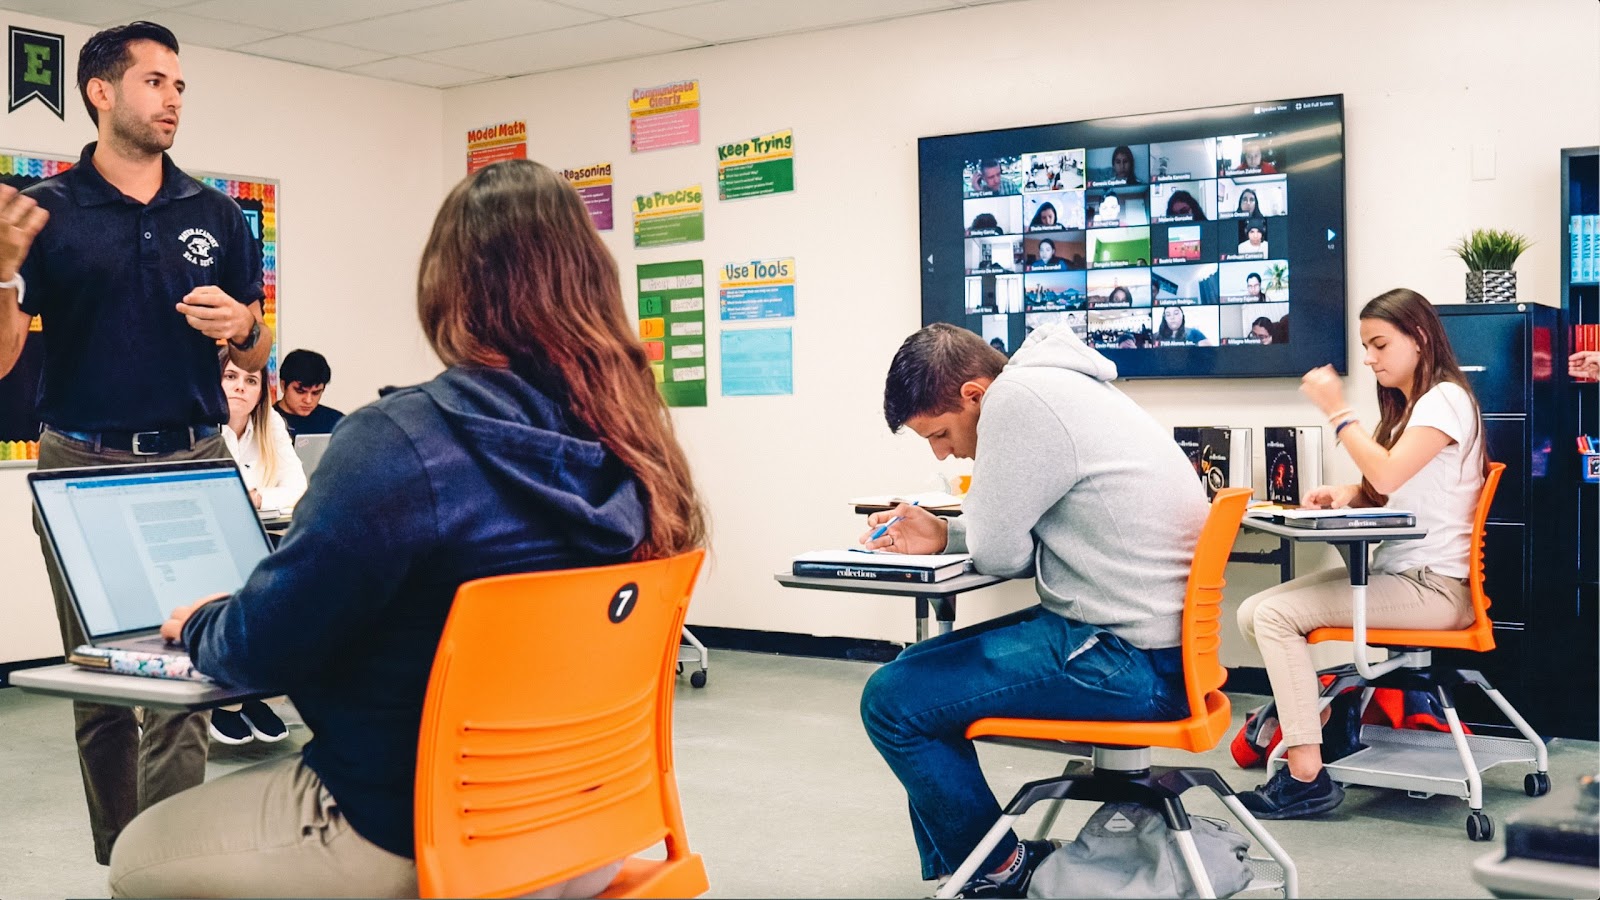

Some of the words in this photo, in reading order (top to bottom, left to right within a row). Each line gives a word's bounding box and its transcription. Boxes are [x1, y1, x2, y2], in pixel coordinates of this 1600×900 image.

[23, 43, 52, 86] E
[633, 82, 694, 103] Communicate
[649, 95, 681, 108] Clearly
[467, 126, 497, 143] Model
[499, 121, 526, 137] Math
[718, 144, 750, 161] Keep
[751, 135, 792, 154] Trying
[564, 164, 612, 181] Reasoning
[636, 196, 654, 212] Be
[654, 191, 702, 207] Precise
[1571, 233, 1579, 258] MATH
[1583, 233, 1591, 258] MATH
[726, 263, 749, 280] Use
[751, 260, 788, 279] Tools
[1348, 519, 1377, 527] collections
[836, 567, 877, 578] collections
[615, 589, 633, 617] 7
